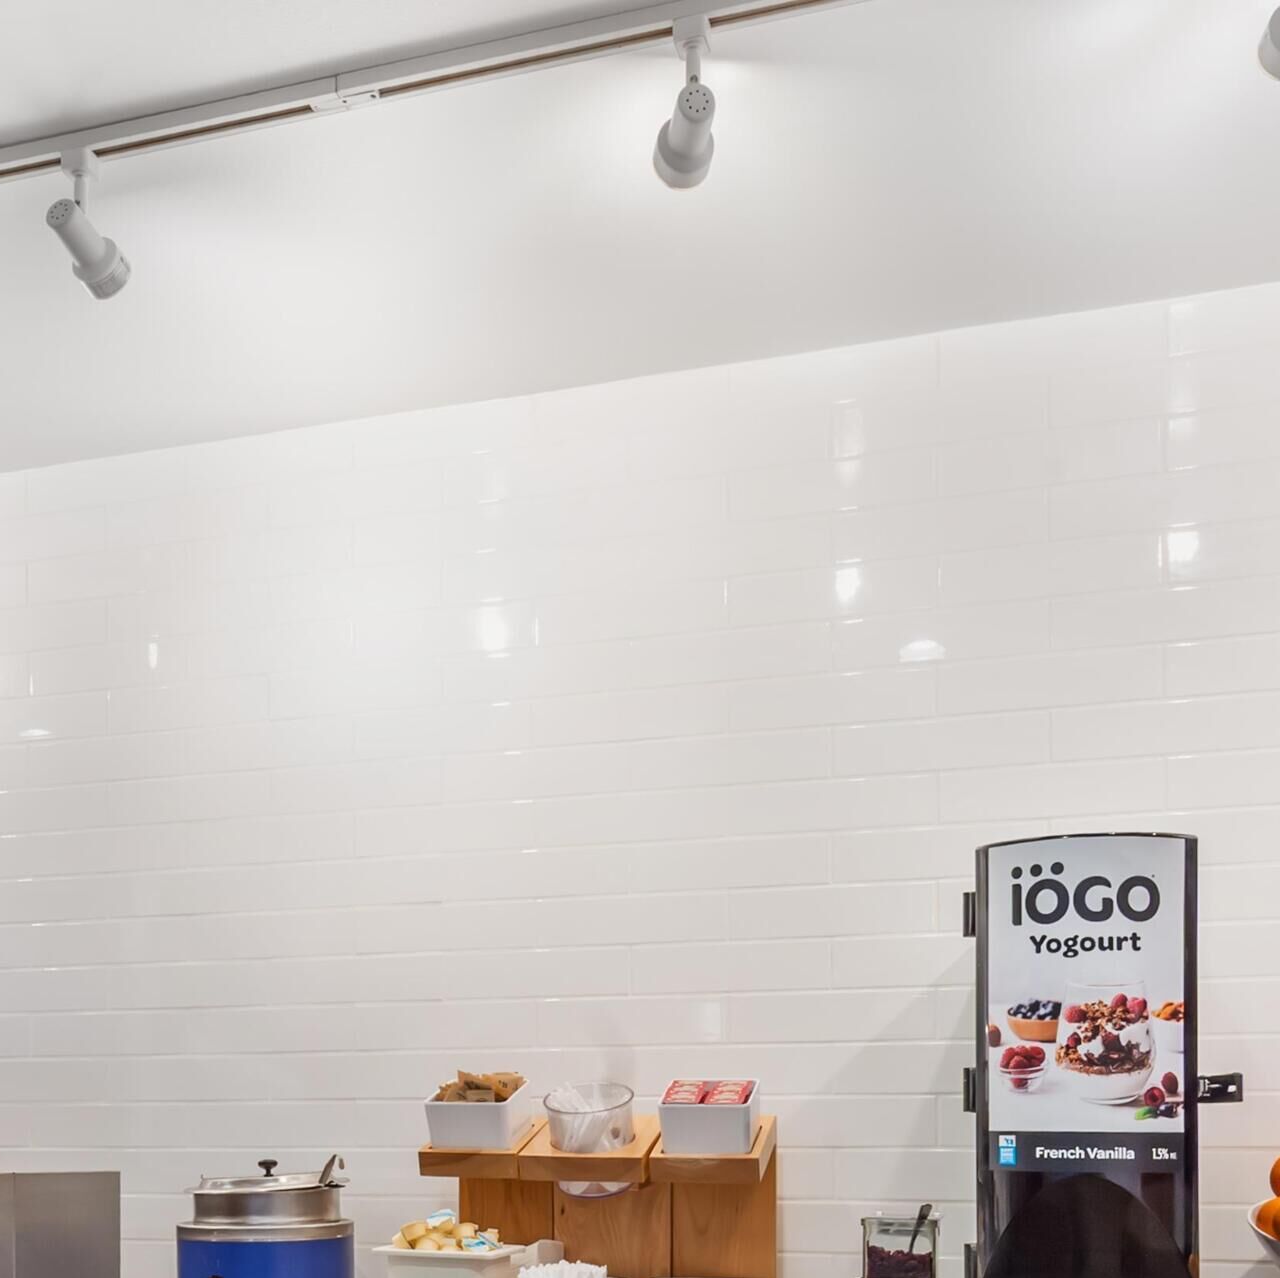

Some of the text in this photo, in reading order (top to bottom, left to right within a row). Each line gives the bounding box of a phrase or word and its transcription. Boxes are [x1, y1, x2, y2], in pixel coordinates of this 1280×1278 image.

[1030, 932, 1141, 958] Yogourt
[1035, 1147, 1085, 1159] French
[1086, 1147, 1135, 1159] Vanilla
